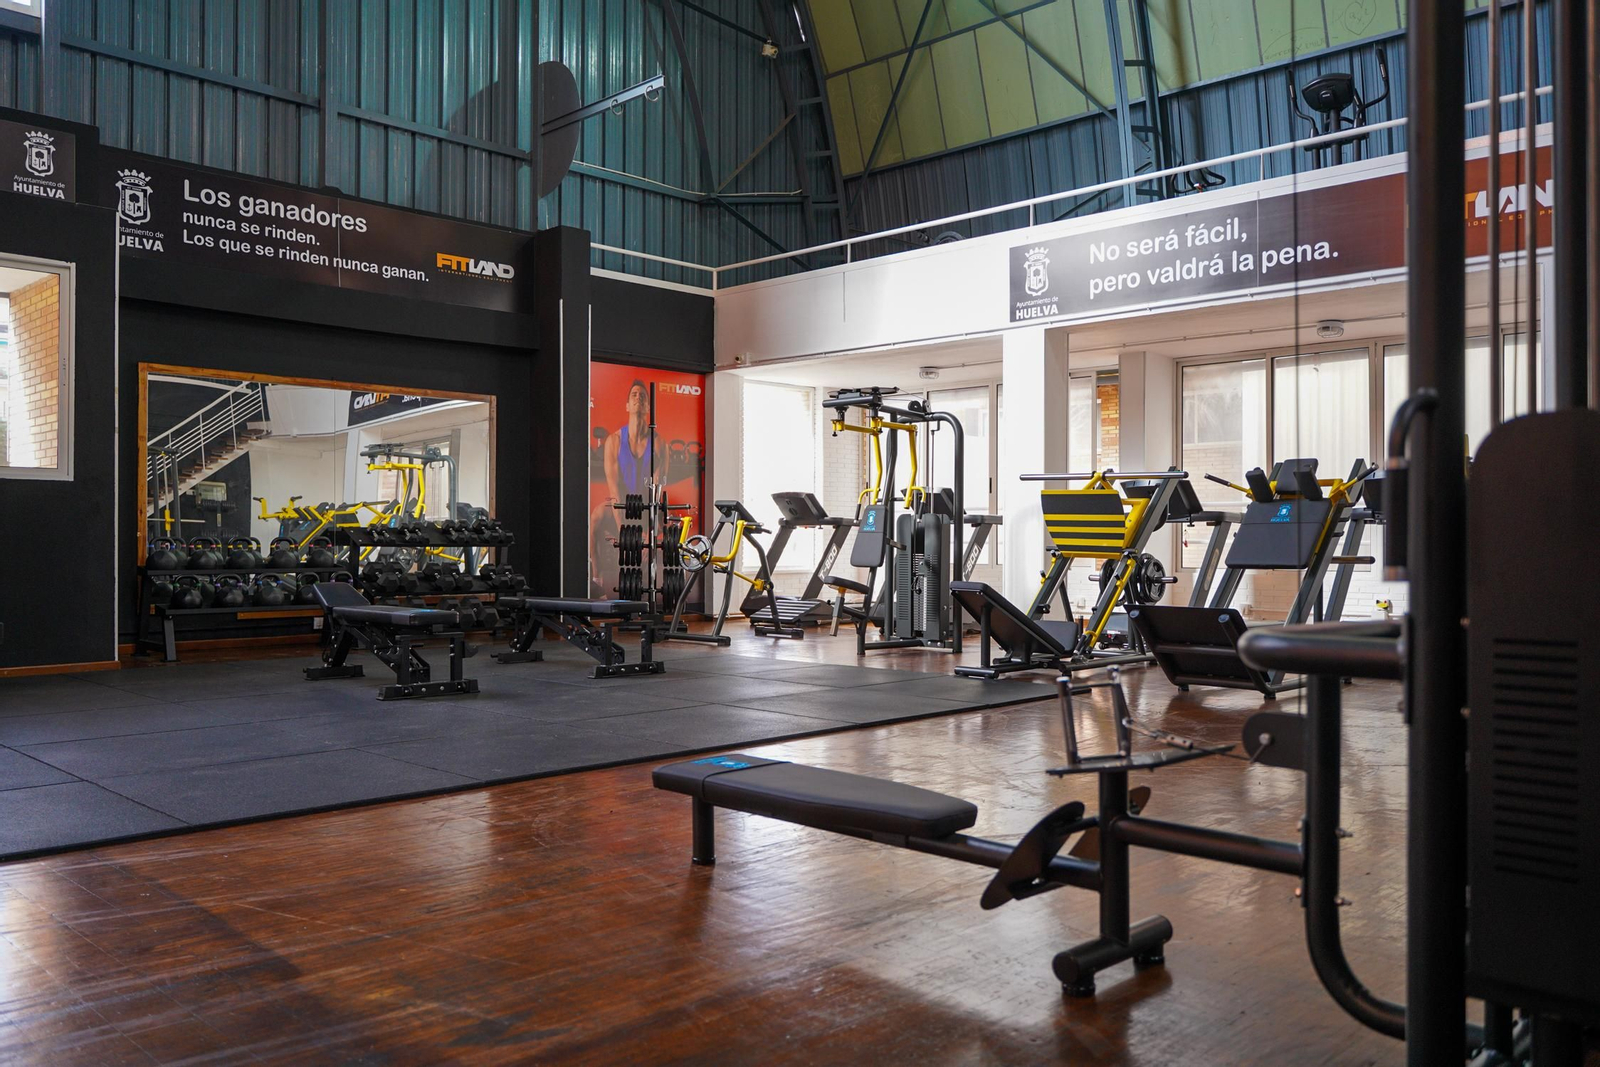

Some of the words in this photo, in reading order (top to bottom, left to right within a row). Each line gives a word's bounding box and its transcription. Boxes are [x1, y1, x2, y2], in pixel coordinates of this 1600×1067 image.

[13, 175, 56, 187] Ayuntamiento
[13, 182, 65, 199] HUELVA
[184, 179, 231, 208] Los
[239, 195, 368, 233] ganadores
[119, 226, 154, 237] ntamiento
[155, 231, 164, 239] de
[183, 212, 236, 231] nunca
[240, 222, 260, 235] se
[264, 224, 320, 246] rinden.
[119, 235, 164, 252] UELVA
[1089, 241, 1120, 264] No
[1126, 228, 1179, 257] será
[1185, 217, 1248, 248] fácil,
[183, 229, 214, 247] Los
[219, 238, 251, 253] que
[255, 244, 274, 257] se
[279, 246, 329, 266] rinden
[333, 256, 379, 274] nunca
[382, 265, 429, 282] ganan.
[1089, 274, 1141, 300] pero
[1147, 253, 1224, 285] valdrá
[1232, 250, 1254, 273] la
[1262, 241, 1339, 274] pena.
[1016, 298, 1051, 308] Ayuntamiento
[1016, 303, 1059, 320] HUELVA
